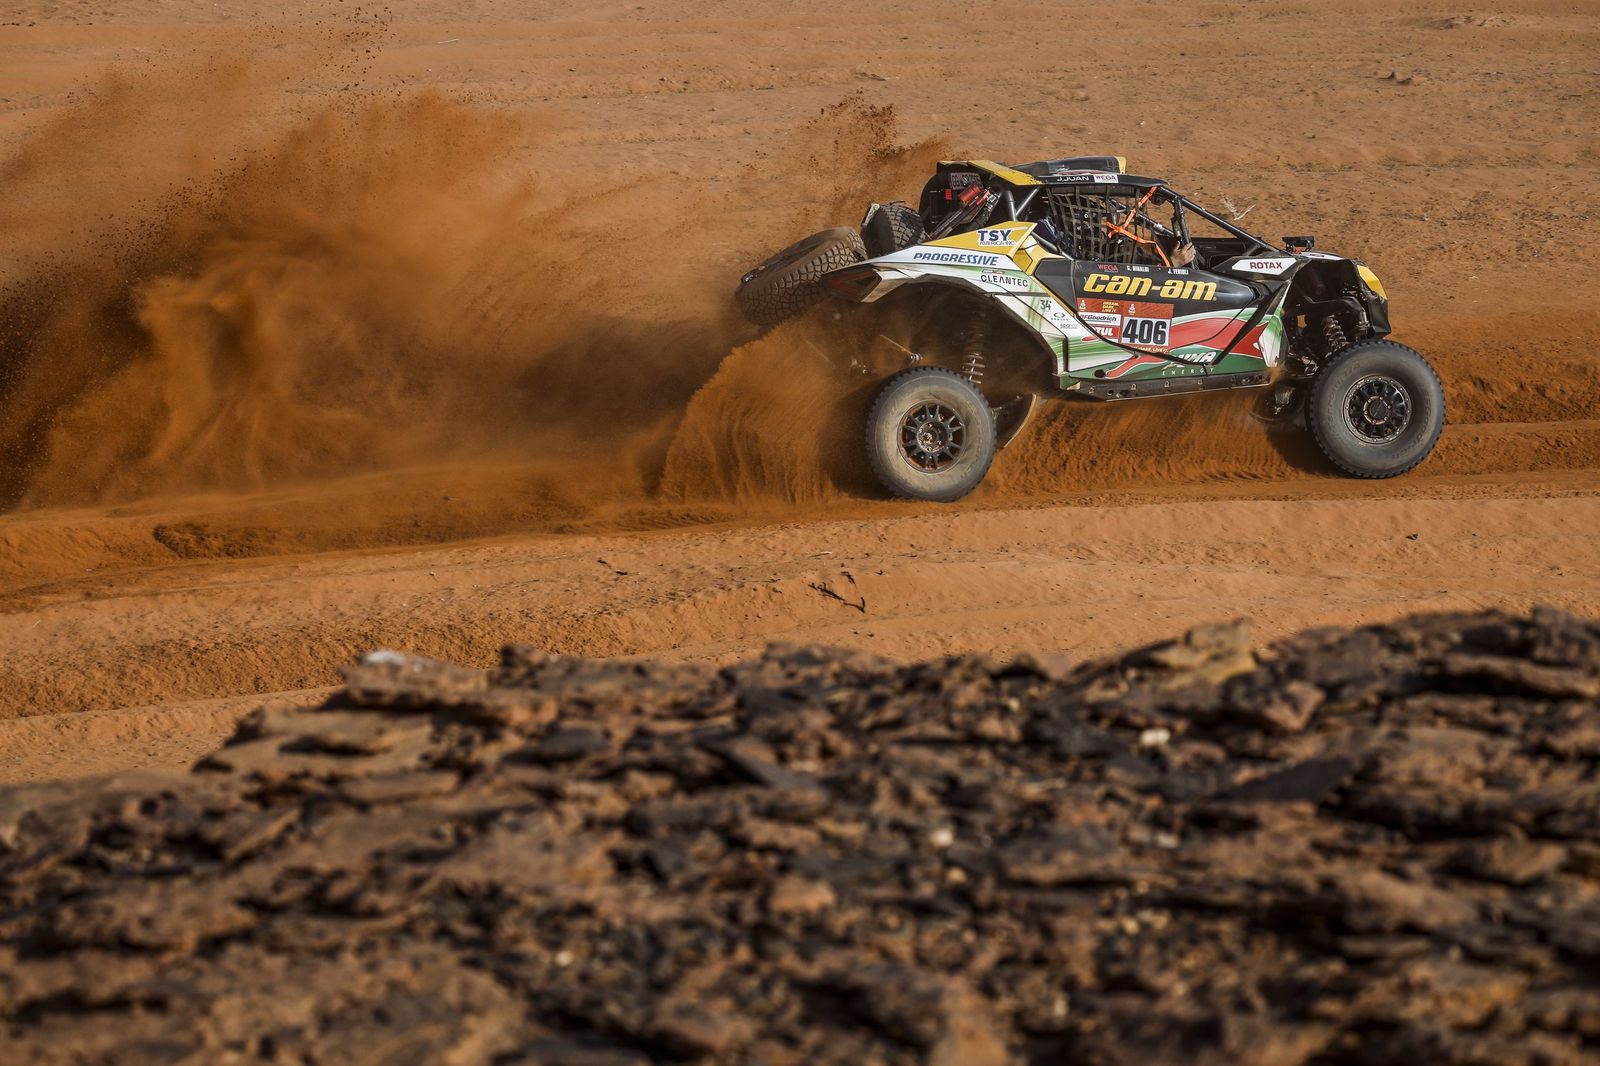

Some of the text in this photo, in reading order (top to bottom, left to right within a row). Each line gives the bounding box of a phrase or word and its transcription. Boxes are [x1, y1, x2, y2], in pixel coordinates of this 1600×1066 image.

[978, 230, 1011, 241] TSY
[913, 252, 999, 266] PROGRESSIVE
[1249, 261, 1283, 270] ROTAX
[1097, 263, 1119, 271] WEGA
[980, 274, 1029, 288] CLEANTEC
[1083, 273, 1217, 301] can-am
[1123, 319, 1167, 345] 406
